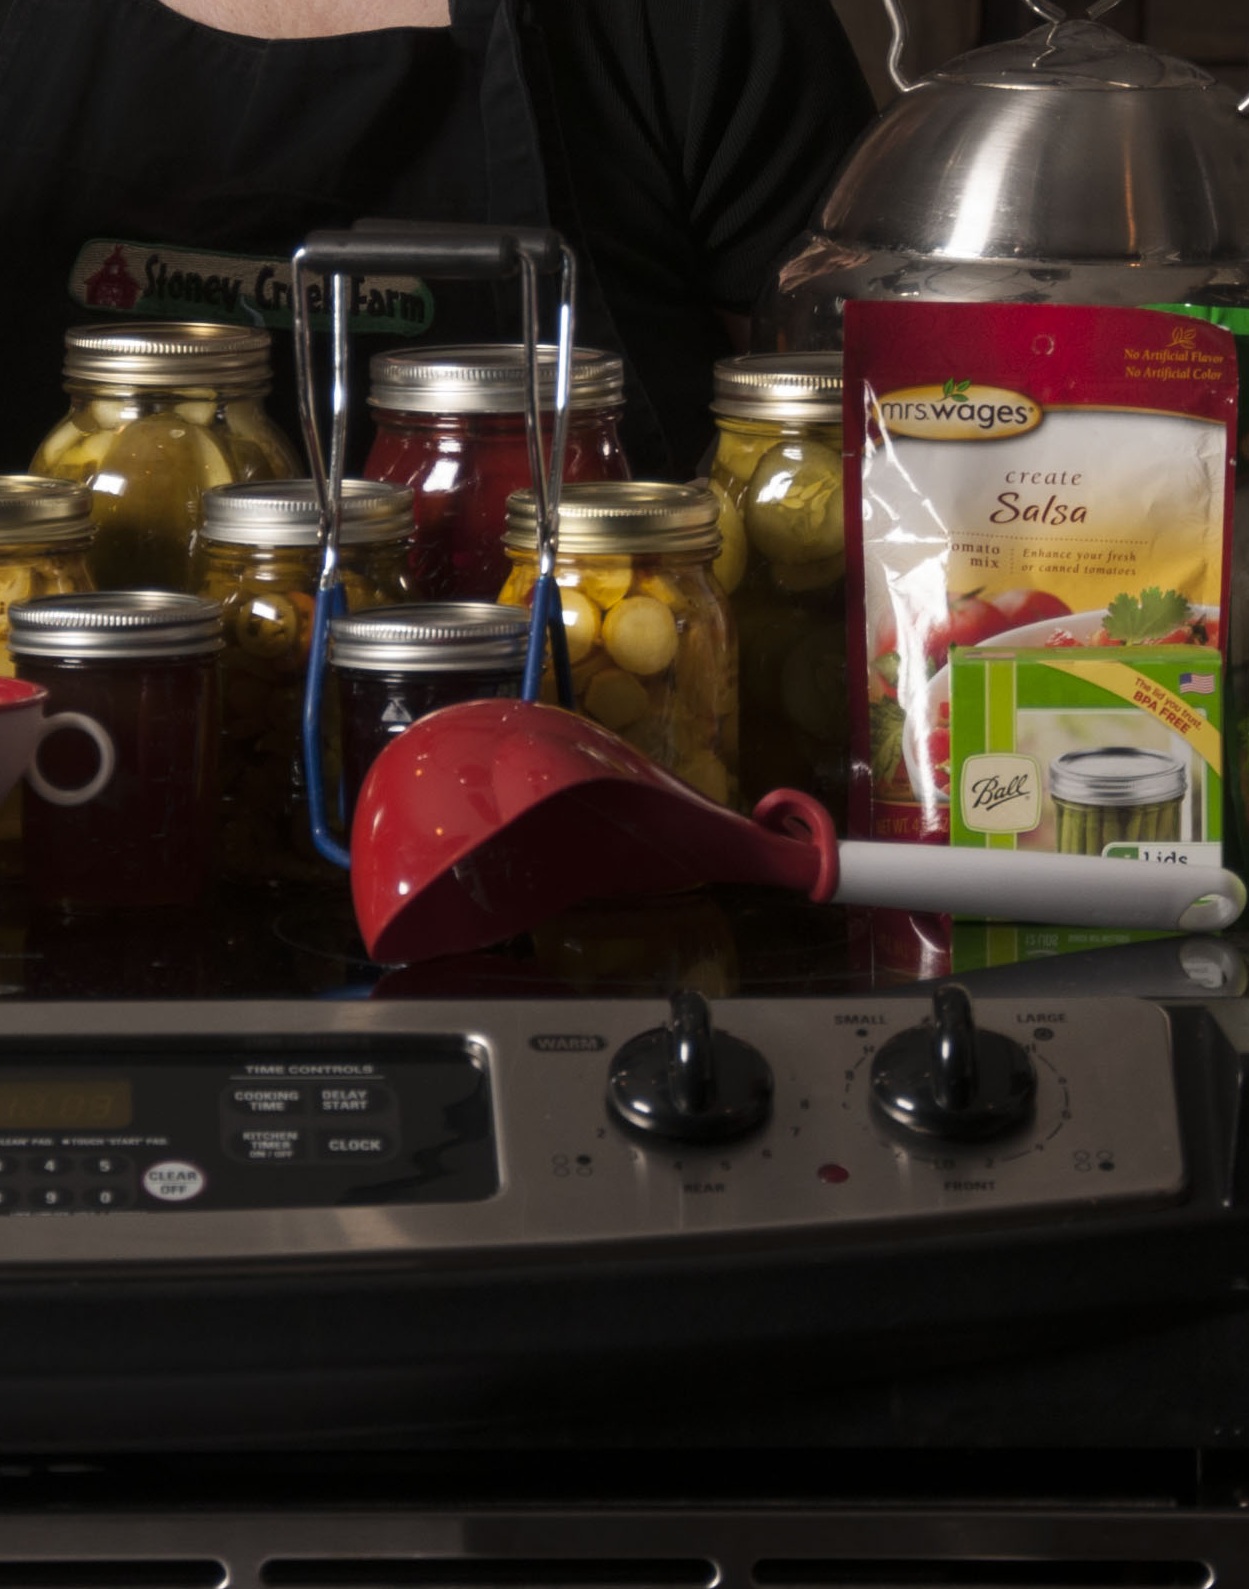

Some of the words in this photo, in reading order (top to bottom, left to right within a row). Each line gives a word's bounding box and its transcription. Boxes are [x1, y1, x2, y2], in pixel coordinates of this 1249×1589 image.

[143, 254, 242, 313] Stoney
[351, 274, 426, 324] Farm
[1123, 348, 1141, 360] No
[1142, 348, 1189, 363] Artificial
[1191, 350, 1225, 364] Flavor
[1124, 366, 1141, 378] No
[1143, 366, 1191, 381] Artificial
[1192, 367, 1223, 381] Color
[1005, 470, 1083, 487] create
[989, 491, 1088, 526] Salsa
[947, 542, 1001, 556] omato
[1022, 548, 1072, 560] Enhance
[1076, 551, 1103, 562] your
[1107, 550, 1137, 563] fresh
[969, 555, 1000, 569] mix
[1021, 563, 1034, 572] or
[1038, 563, 1079, 574] canned
[1084, 565, 1137, 577] tomatoes
[1135, 677, 1152, 692] The
[1152, 687, 1166, 701] lid
[1164, 698, 1182, 713] you
[1132, 690, 1158, 712] BPA
[1158, 706, 1192, 734] FREE
[971, 773, 1030, 812] Ball
[834, 1014, 887, 1025] SMALL
[1016, 1013, 1068, 1024] LARGE
[537, 1038, 599, 1051] WARM
[244, 1064, 284, 1075] TIME
[288, 1063, 375, 1075] CONTROLS
[234, 1089, 300, 1102] COOKING
[321, 1089, 368, 1101] DELAY
[248, 1101, 286, 1112] TIME
[322, 1101, 368, 1112] START
[242, 1131, 298, 1142] KITCHEN
[251, 1141, 290, 1151] TIMER
[328, 1139, 383, 1152] CLOCK
[44, 1159, 57, 1172] 4
[98, 1159, 111, 1172] 5
[148, 1171, 198, 1182] CLEAR
[160, 1183, 188, 1195] OFF
[683, 1182, 725, 1193] REAR
[943, 1180, 996, 1191] FRONT
[45, 1191, 57, 1205] 9
